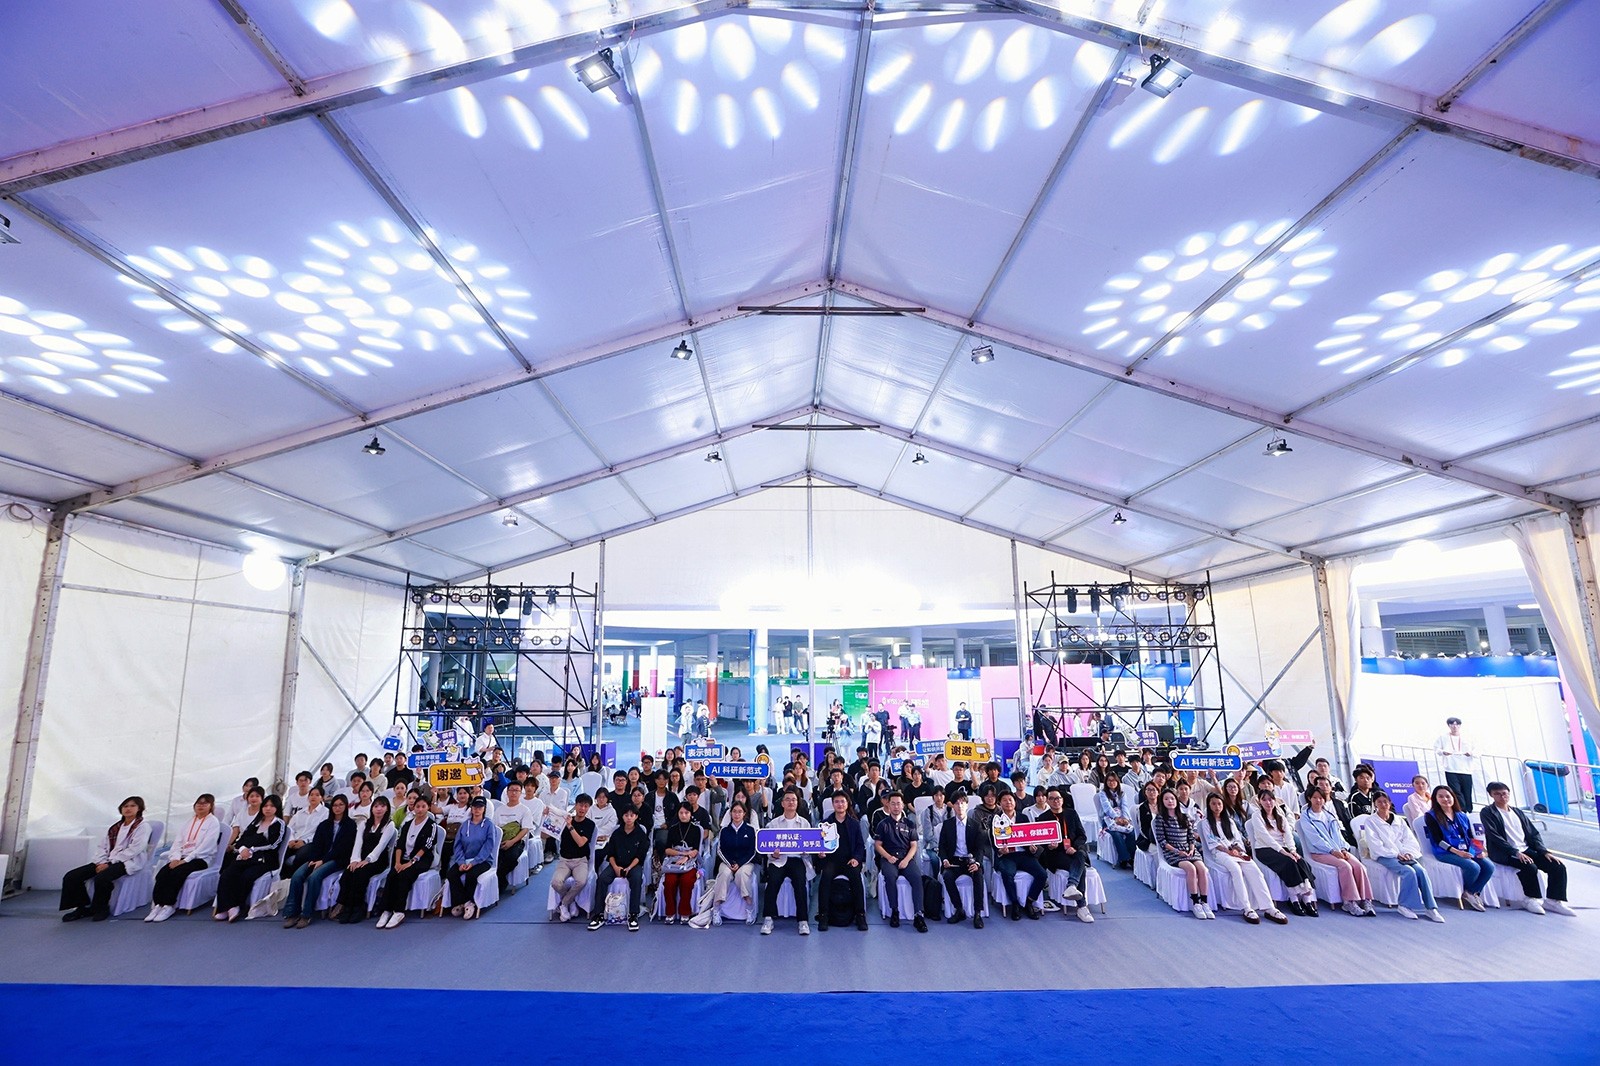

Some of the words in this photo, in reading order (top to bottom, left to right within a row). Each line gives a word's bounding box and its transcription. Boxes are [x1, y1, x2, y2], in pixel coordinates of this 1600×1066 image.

[687, 748, 720, 757] 表示赞同
[951, 745, 972, 757] 谢邀
[1191, 758, 1234, 767] 科研新范式
[436, 768, 462, 781] 谢邀
[711, 766, 720, 774] AI
[722, 766, 762, 775] 科研新范式
